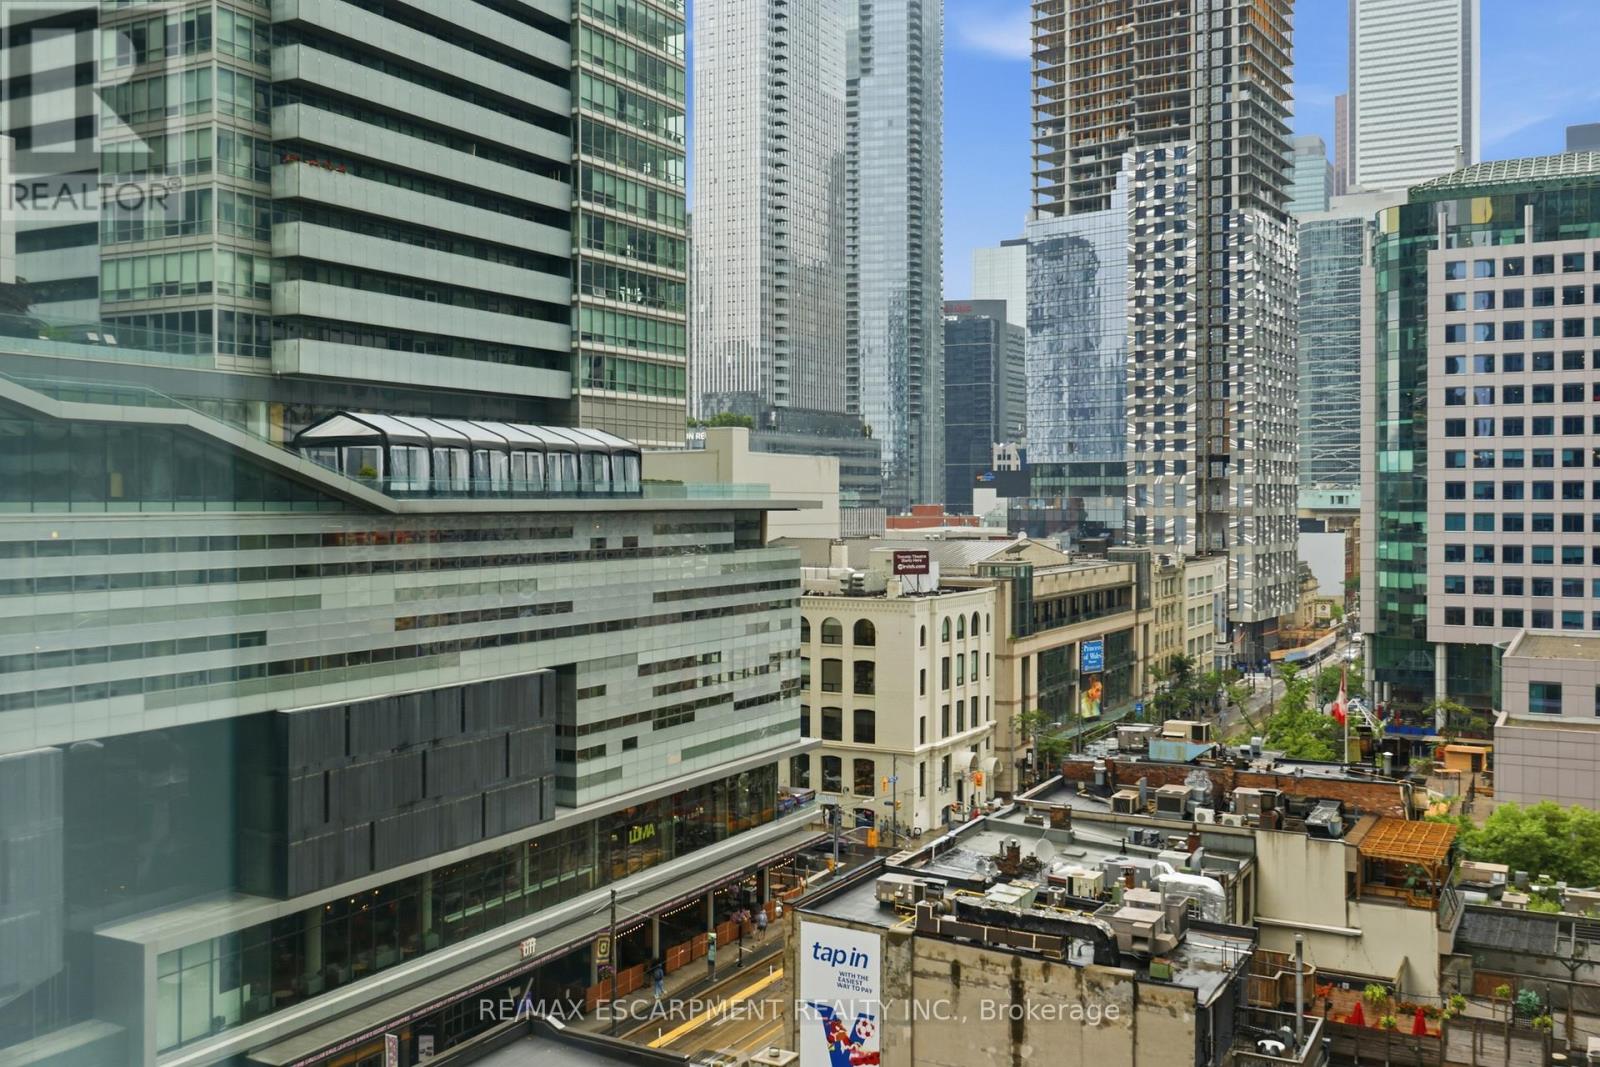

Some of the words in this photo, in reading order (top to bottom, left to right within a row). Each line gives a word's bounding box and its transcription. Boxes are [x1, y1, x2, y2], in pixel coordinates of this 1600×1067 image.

[813, 942, 847, 967] tap
[850, 947, 868, 968] in
[839, 971, 856, 979] WITH
[838, 976, 863, 986] EASIEST
